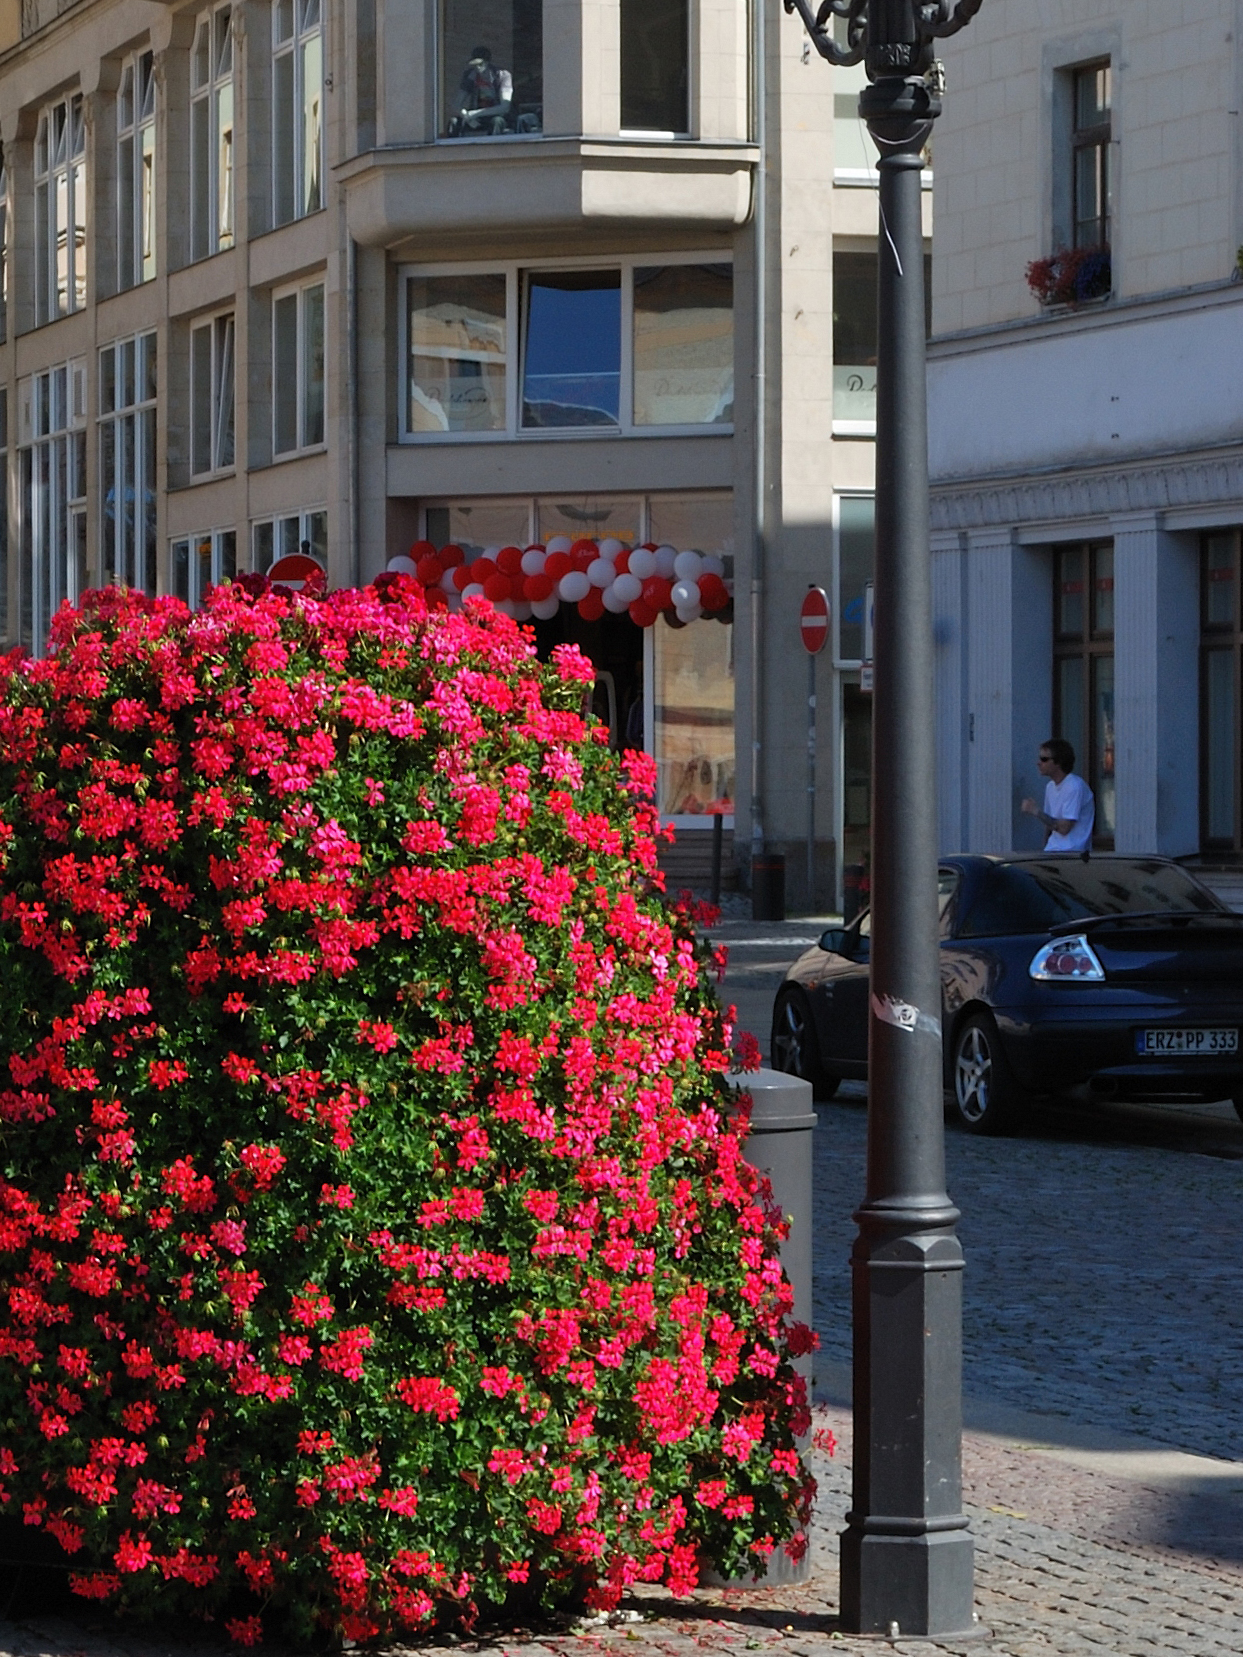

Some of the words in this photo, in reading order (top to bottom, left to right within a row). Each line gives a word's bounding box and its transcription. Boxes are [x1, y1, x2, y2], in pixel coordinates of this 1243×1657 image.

[1146, 1032, 1175, 1049] ERZ
[1186, 1032, 1204, 1049] PP
[1209, 1031, 1236, 1048] 333
